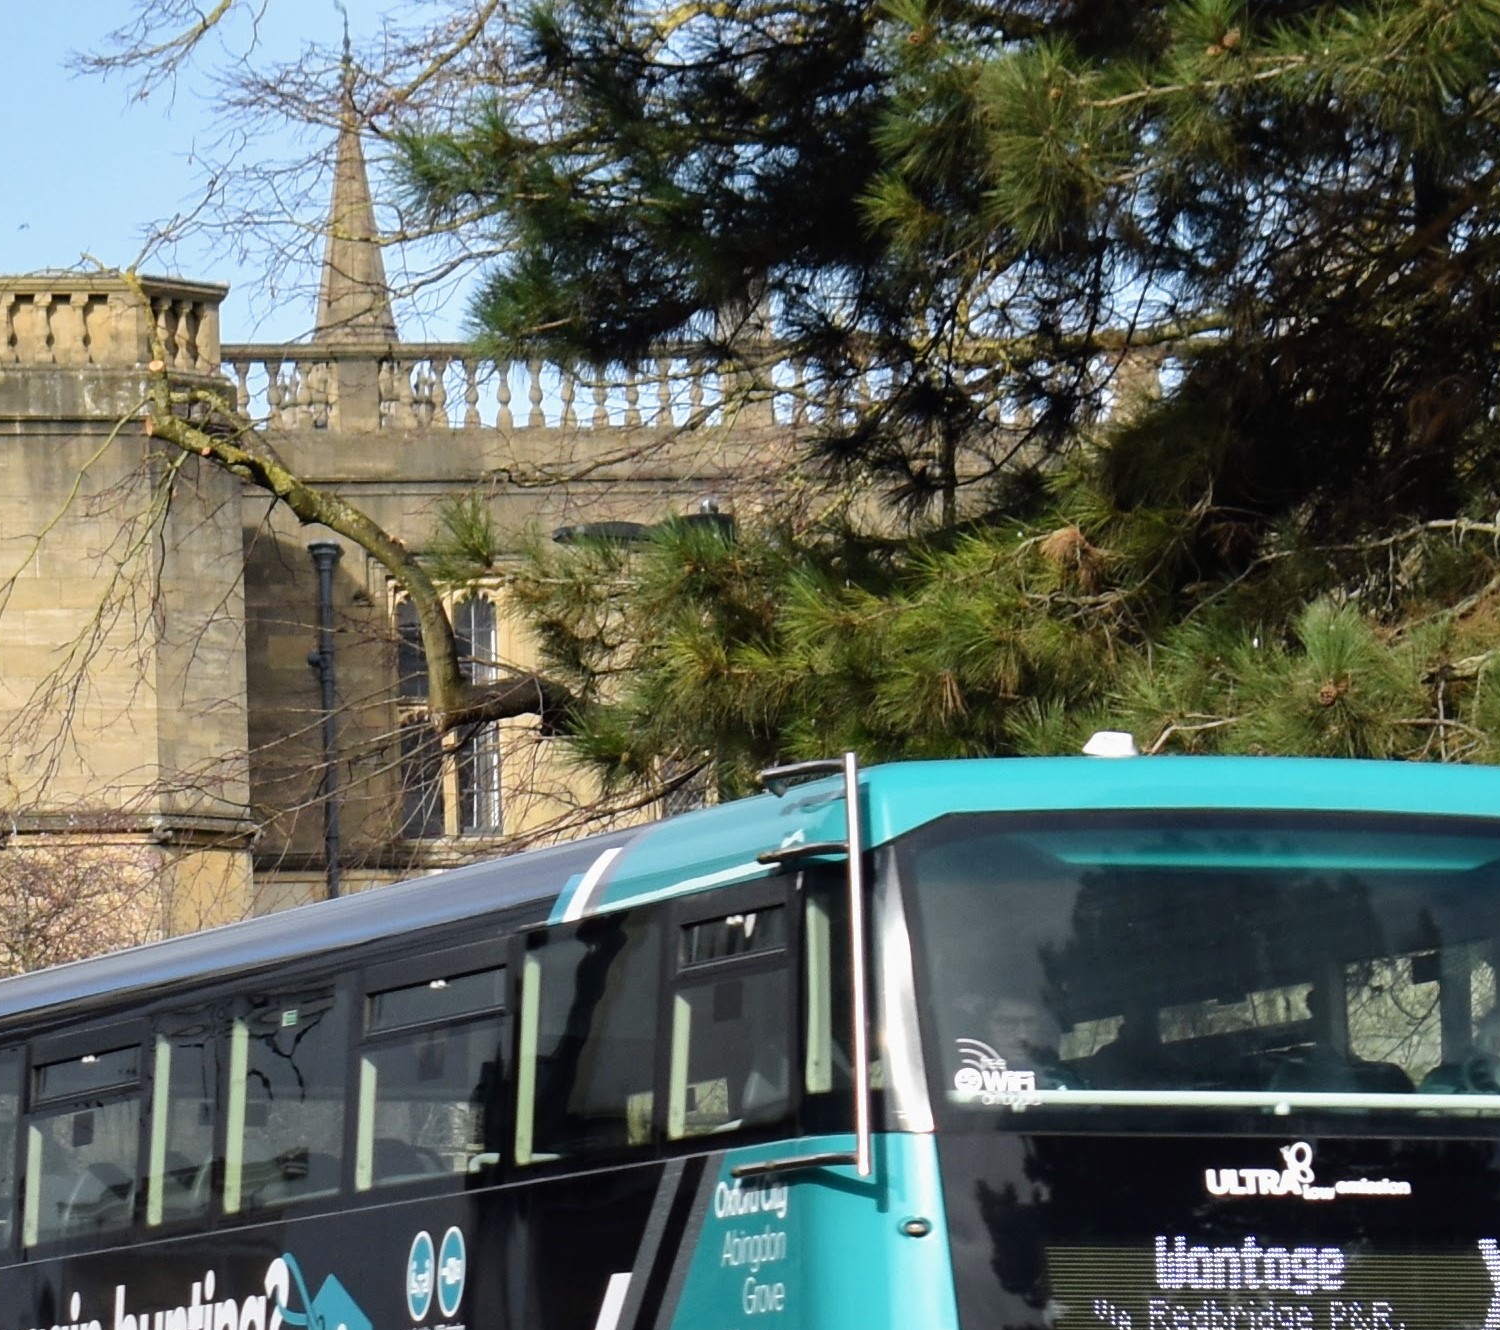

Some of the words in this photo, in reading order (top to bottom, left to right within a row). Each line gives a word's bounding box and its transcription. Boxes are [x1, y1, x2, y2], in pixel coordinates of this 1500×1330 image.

[1205, 1168, 1302, 1196] ULTRA
[1335, 1177, 1412, 1195] emission
[720, 1224, 788, 1273] Abingdon
[1155, 1235, 1345, 1295] Wantage
[742, 1276, 786, 1315] Grove
